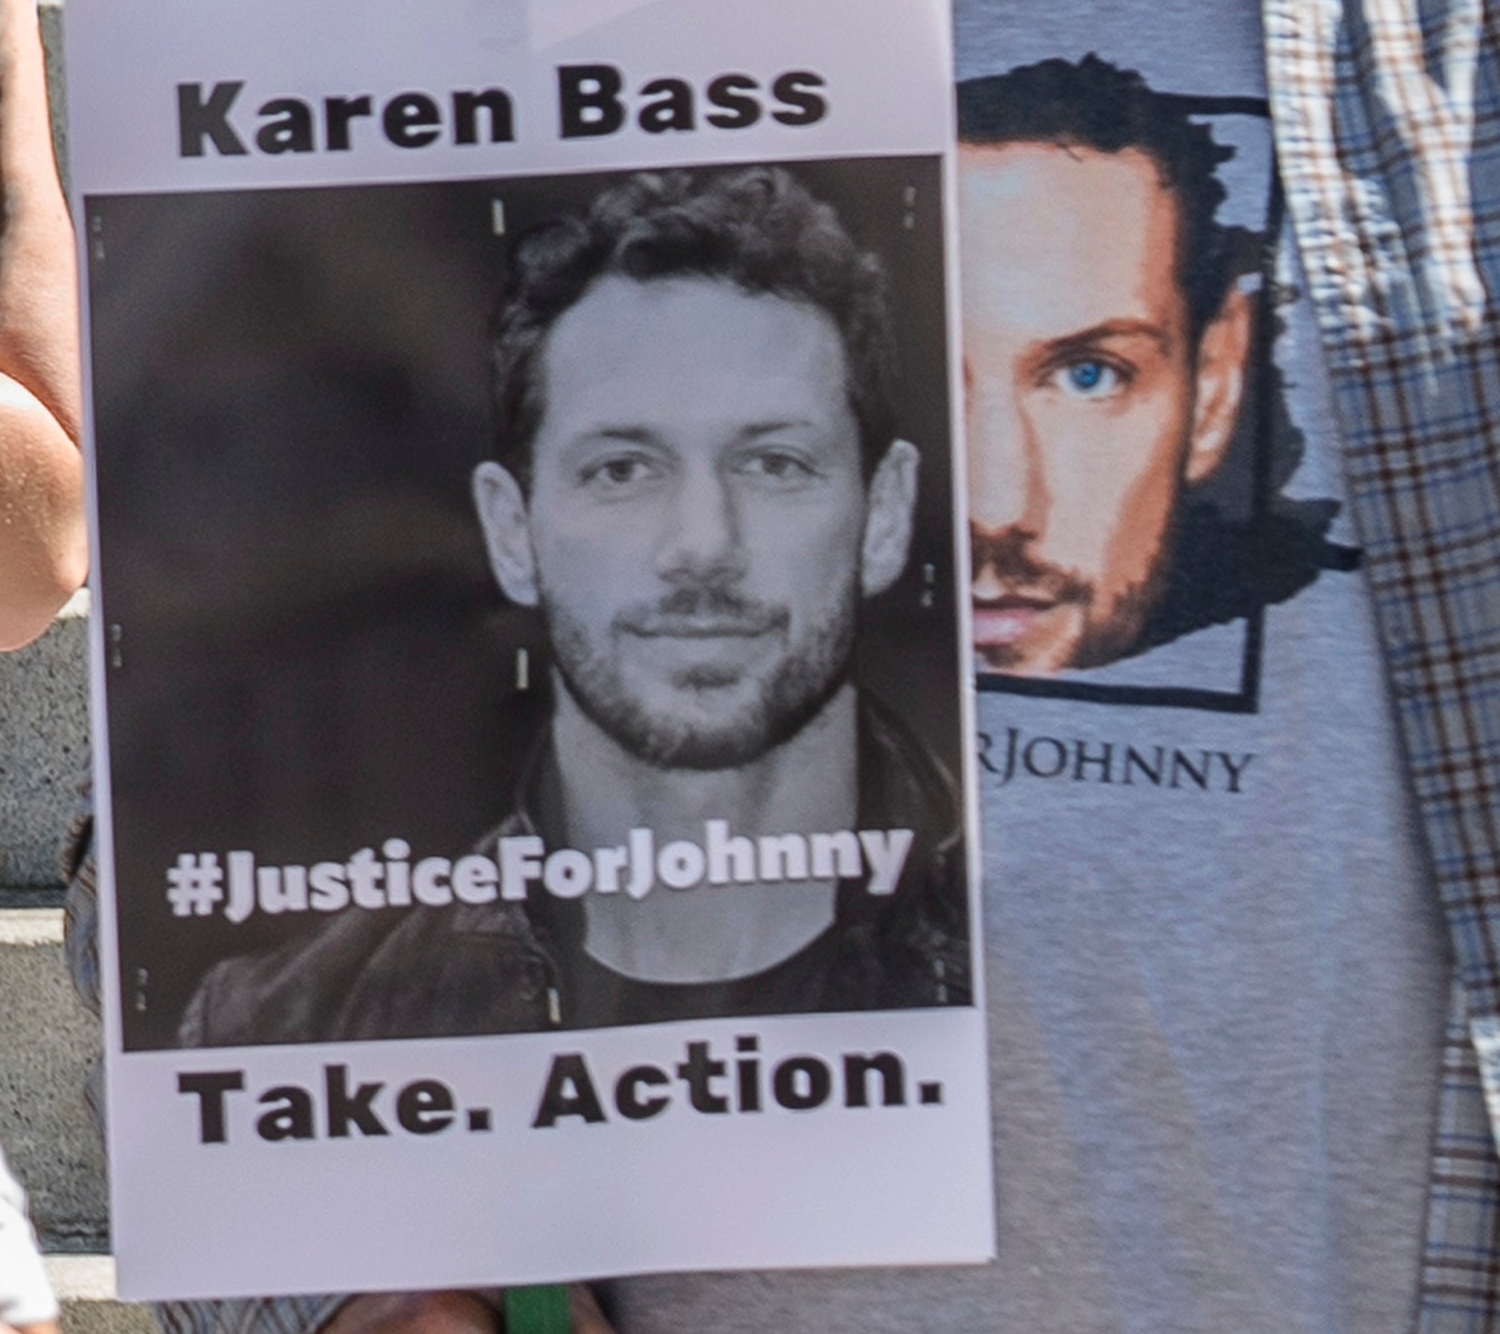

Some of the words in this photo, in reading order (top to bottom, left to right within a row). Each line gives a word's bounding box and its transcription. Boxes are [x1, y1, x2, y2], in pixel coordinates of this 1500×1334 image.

[177, 81, 515, 158] Karen
[556, 64, 827, 140] Bass
[165, 818, 913, 923] #JusticeForJohnny
[177, 1064, 491, 1144] Take.
[531, 1035, 941, 1129] Action.
